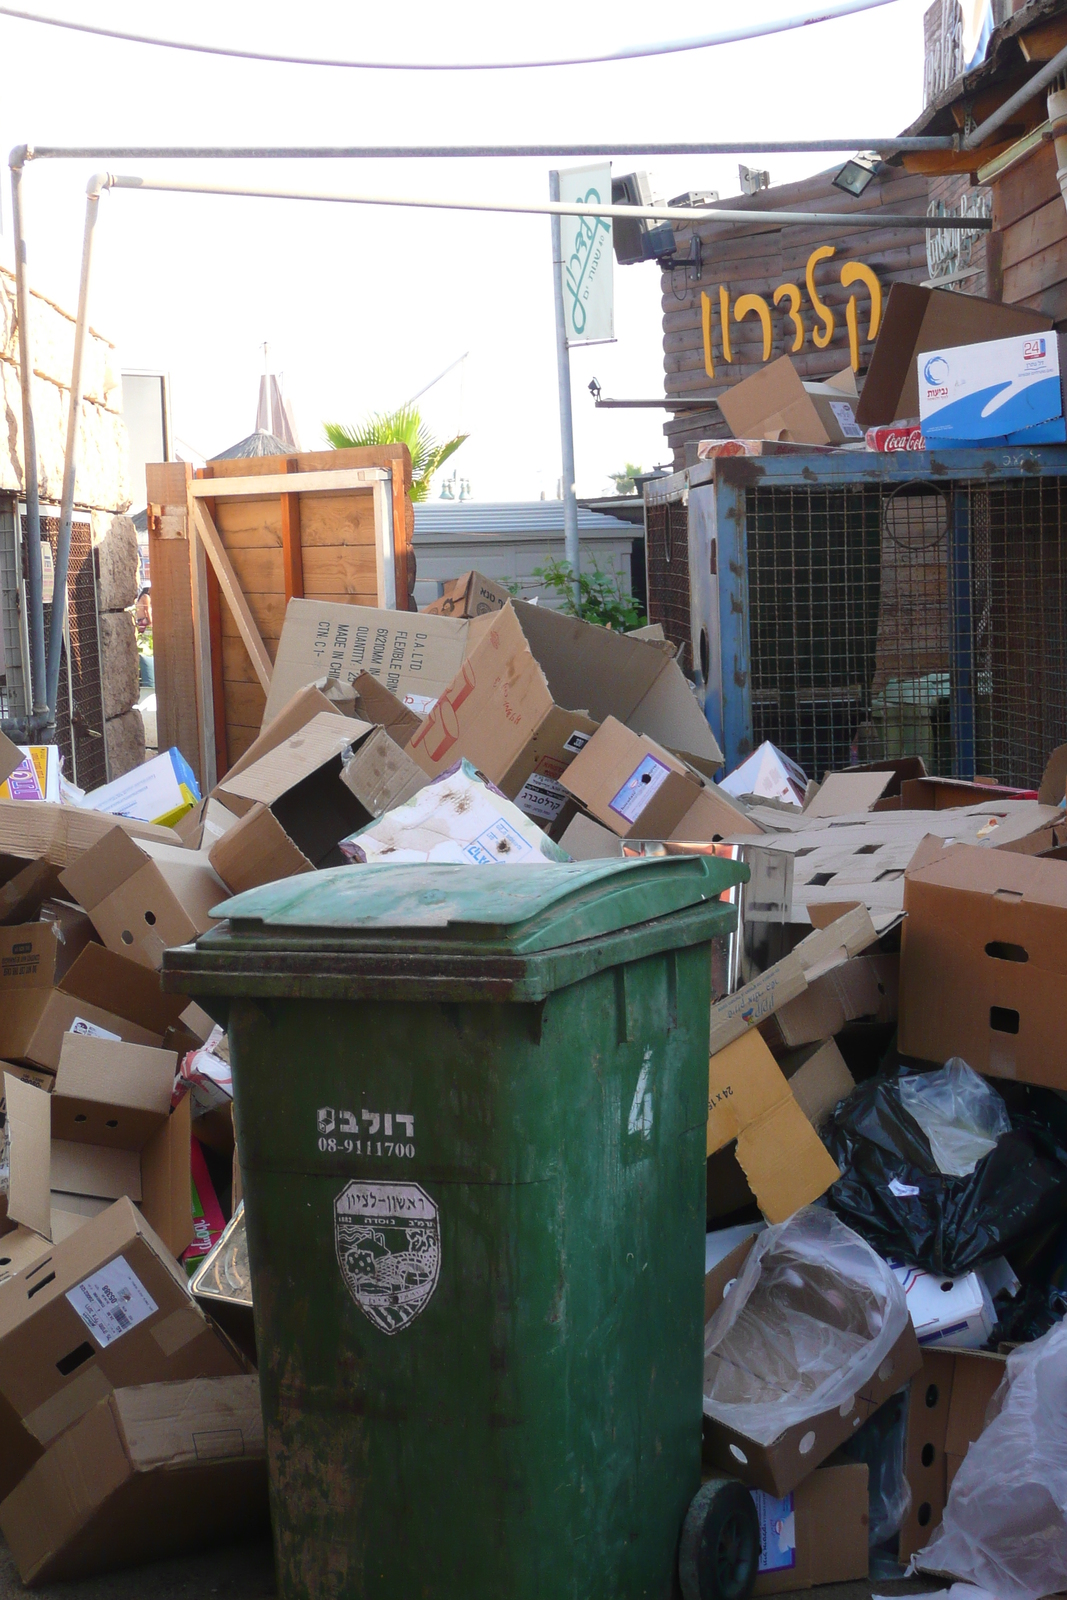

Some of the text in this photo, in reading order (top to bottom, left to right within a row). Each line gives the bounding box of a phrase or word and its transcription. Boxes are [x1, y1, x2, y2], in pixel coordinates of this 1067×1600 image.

[588, 248, 602, 281] שנות
[1024, 341, 1039, 355] 24
[927, 387, 948, 398] נביעות
[334, 624, 349, 648] MADE
[332, 650, 344, 660] IN
[369, 628, 388, 676] 6X210MM IN
[386, 630, 407, 696] FLEXIBLE DRIN
[520, 792, 561, 811] קרלסברג
[722, 1085, 734, 1097] 24
[339, 1108, 415, 1137] דולב
[317, 1137, 416, 1159] 08-9111700
[345, 1193, 425, 1213] ראשון-לציון
[364, 1217, 396, 1226] נוסדה
